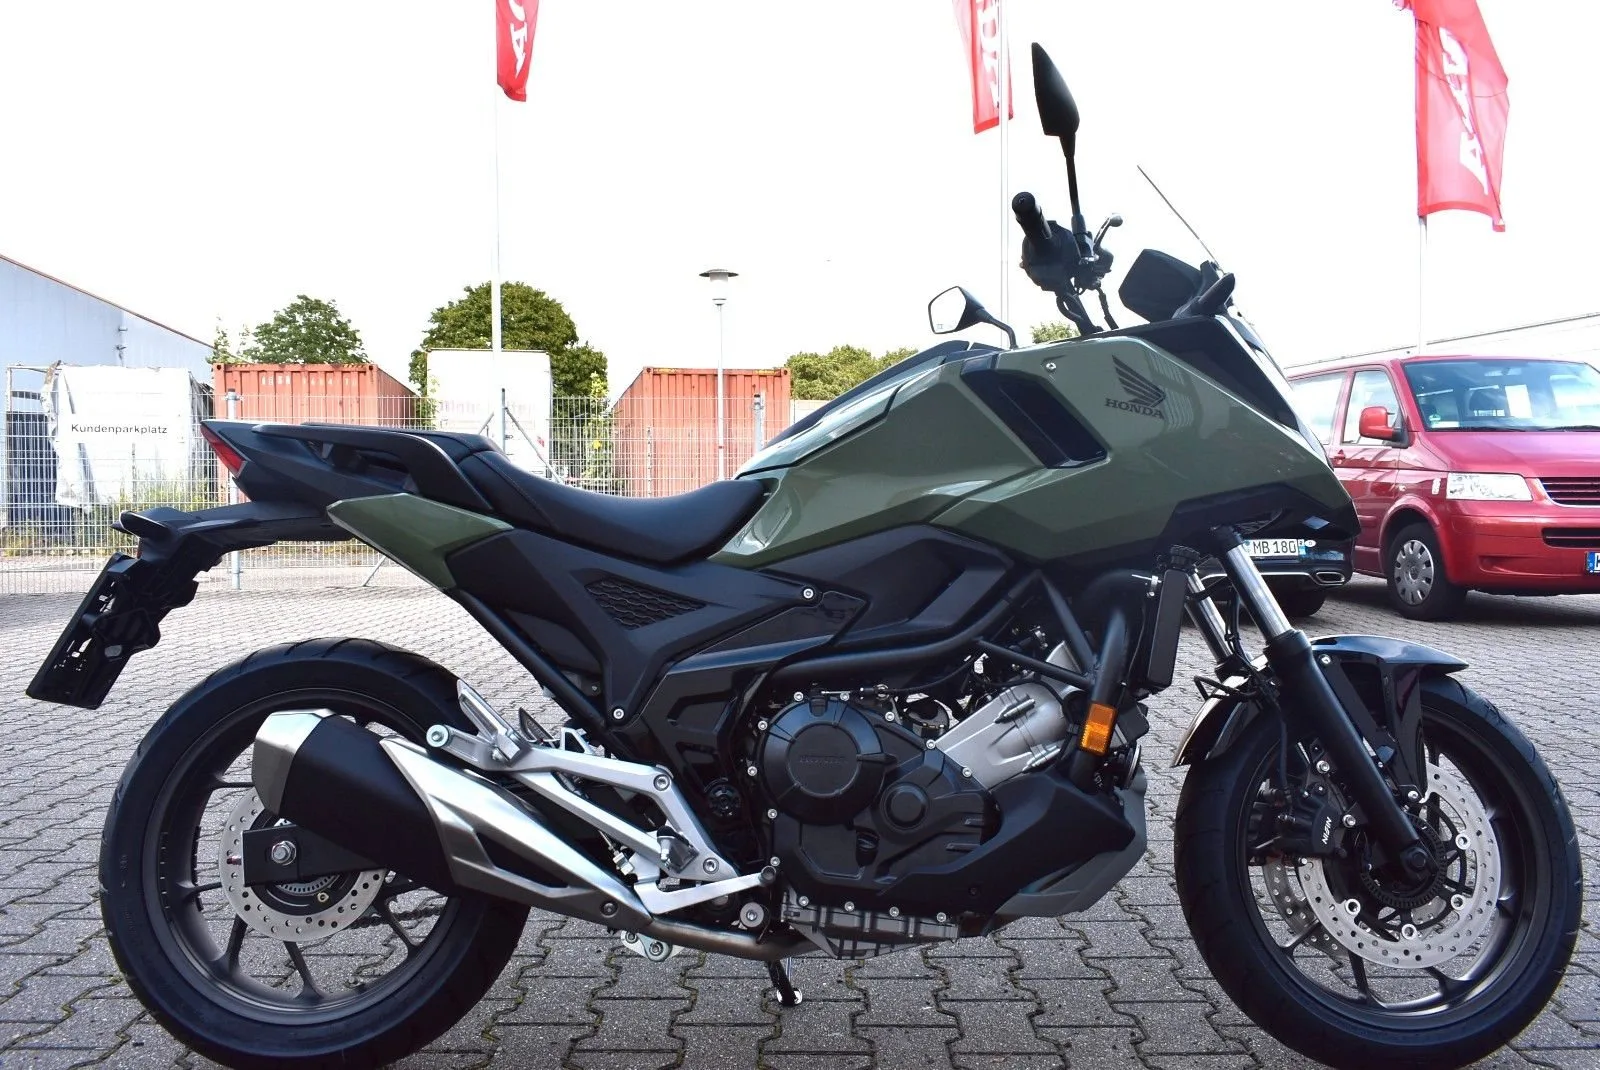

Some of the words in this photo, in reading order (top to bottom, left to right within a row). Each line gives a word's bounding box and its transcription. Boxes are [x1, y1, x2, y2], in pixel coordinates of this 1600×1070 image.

[1105, 398, 1164, 420] HONDA
[71, 423, 168, 435] Kundenparkplatz
[1253, 540, 1270, 554] MB
[1273, 540, 1297, 554] 180
